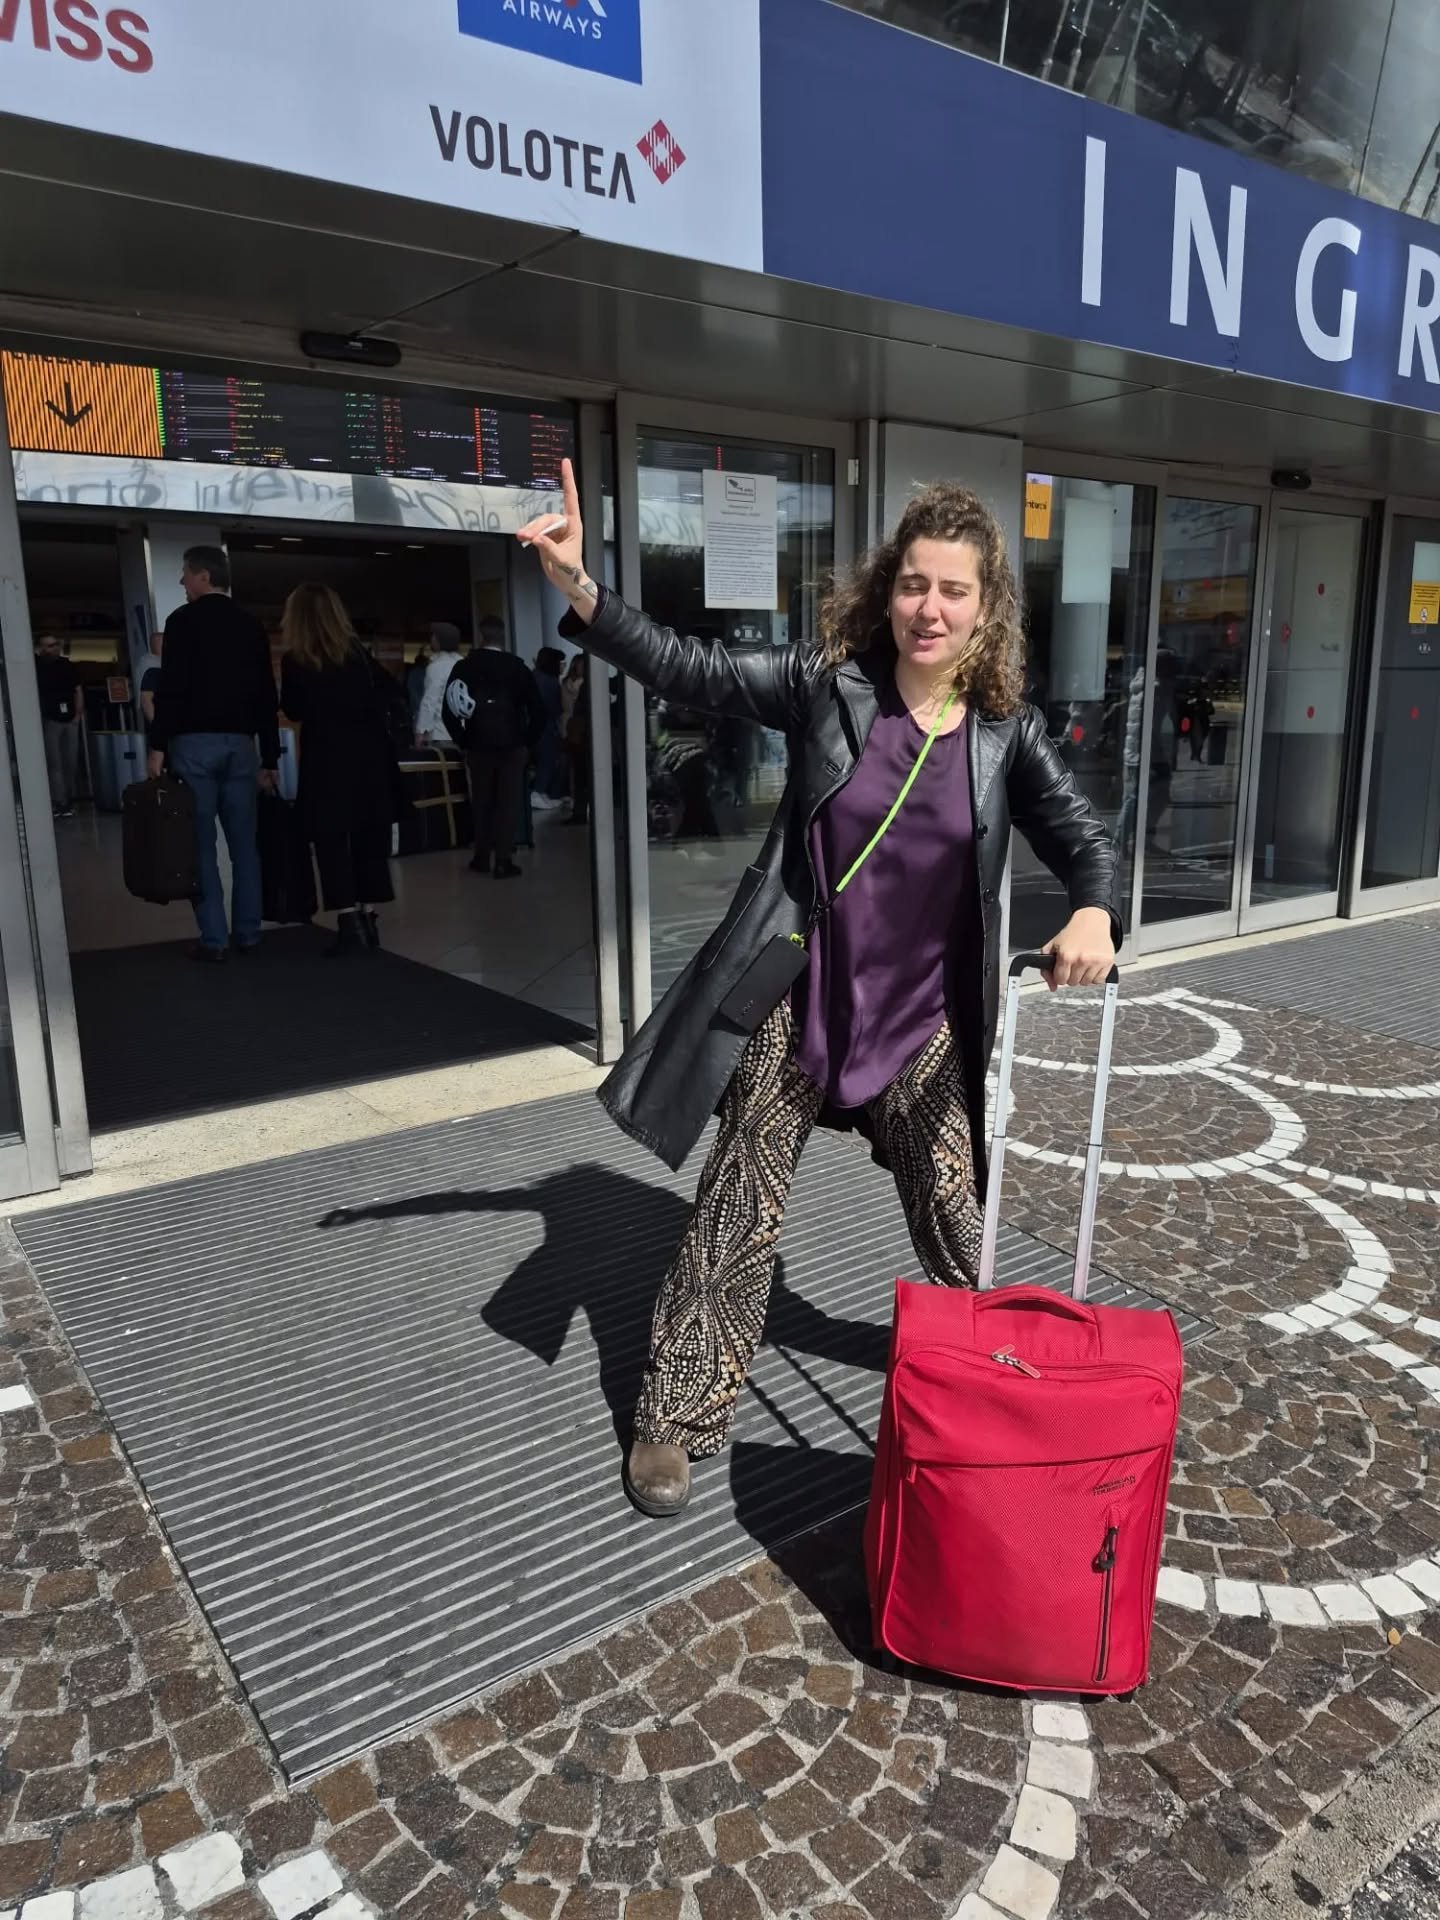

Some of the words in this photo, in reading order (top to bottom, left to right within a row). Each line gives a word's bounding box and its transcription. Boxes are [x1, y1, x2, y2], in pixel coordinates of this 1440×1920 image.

[503, 0, 602, 39] AIRWAYS
[429, 104, 636, 203] VOLOTEA
[1081, 136, 1440, 385] INGR
